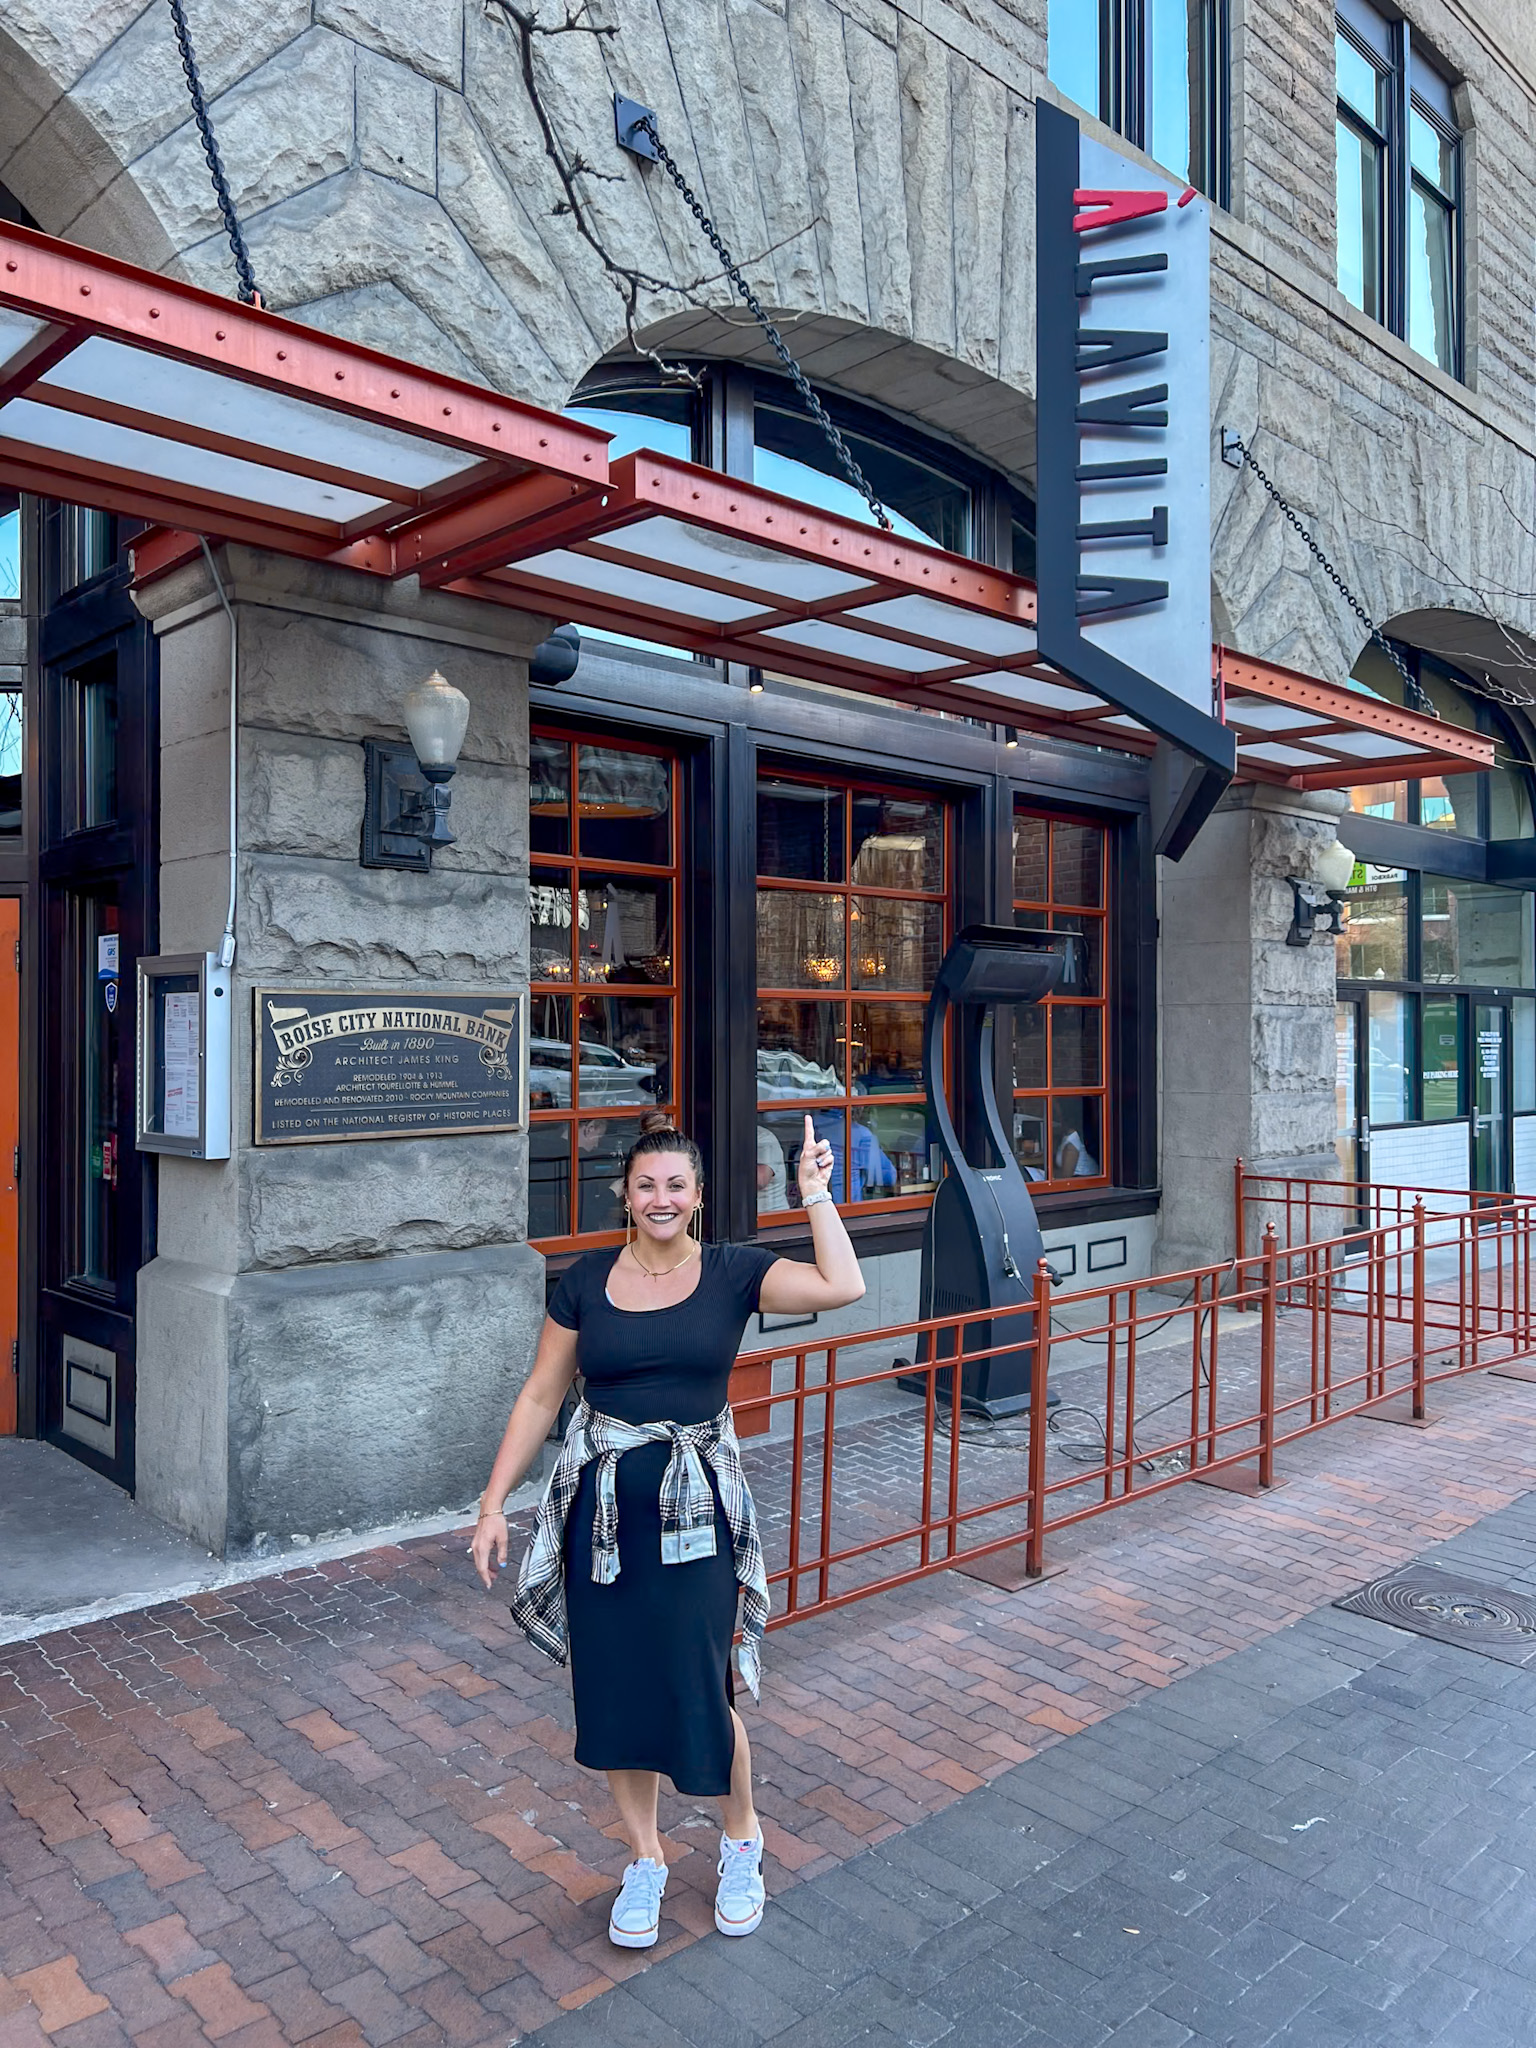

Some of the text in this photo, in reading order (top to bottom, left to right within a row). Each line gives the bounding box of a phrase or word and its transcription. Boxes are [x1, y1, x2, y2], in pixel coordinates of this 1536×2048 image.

[280, 1012, 507, 1050] BOISE CITY NATIONAL BANK
[360, 1037, 435, 1051] Built in 1890
[335, 1055, 460, 1066] ARCHITECT JAMES KING
[353, 1073, 397, 1082] REMODELED
[426, 1072, 443, 1080] 1913
[336, 1080, 459, 1092] ARCHITECT TOURELLOTTE & HUMMEL
[274, 1097, 322, 1107] REMODELED
[323, 1096, 340, 1105] AND
[341, 1094, 384, 1104] RENOVATED
[385, 1093, 403, 1103] 2010
[410, 1092, 434, 1101] ROCKY
[435, 1091, 470, 1100] MOUNTAIN
[471, 1089, 510, 1099] COMPANIES
[272, 1108, 512, 1129] LISTED ON THE NATIONAL REGISTRY OF HISTORIC PLACES
